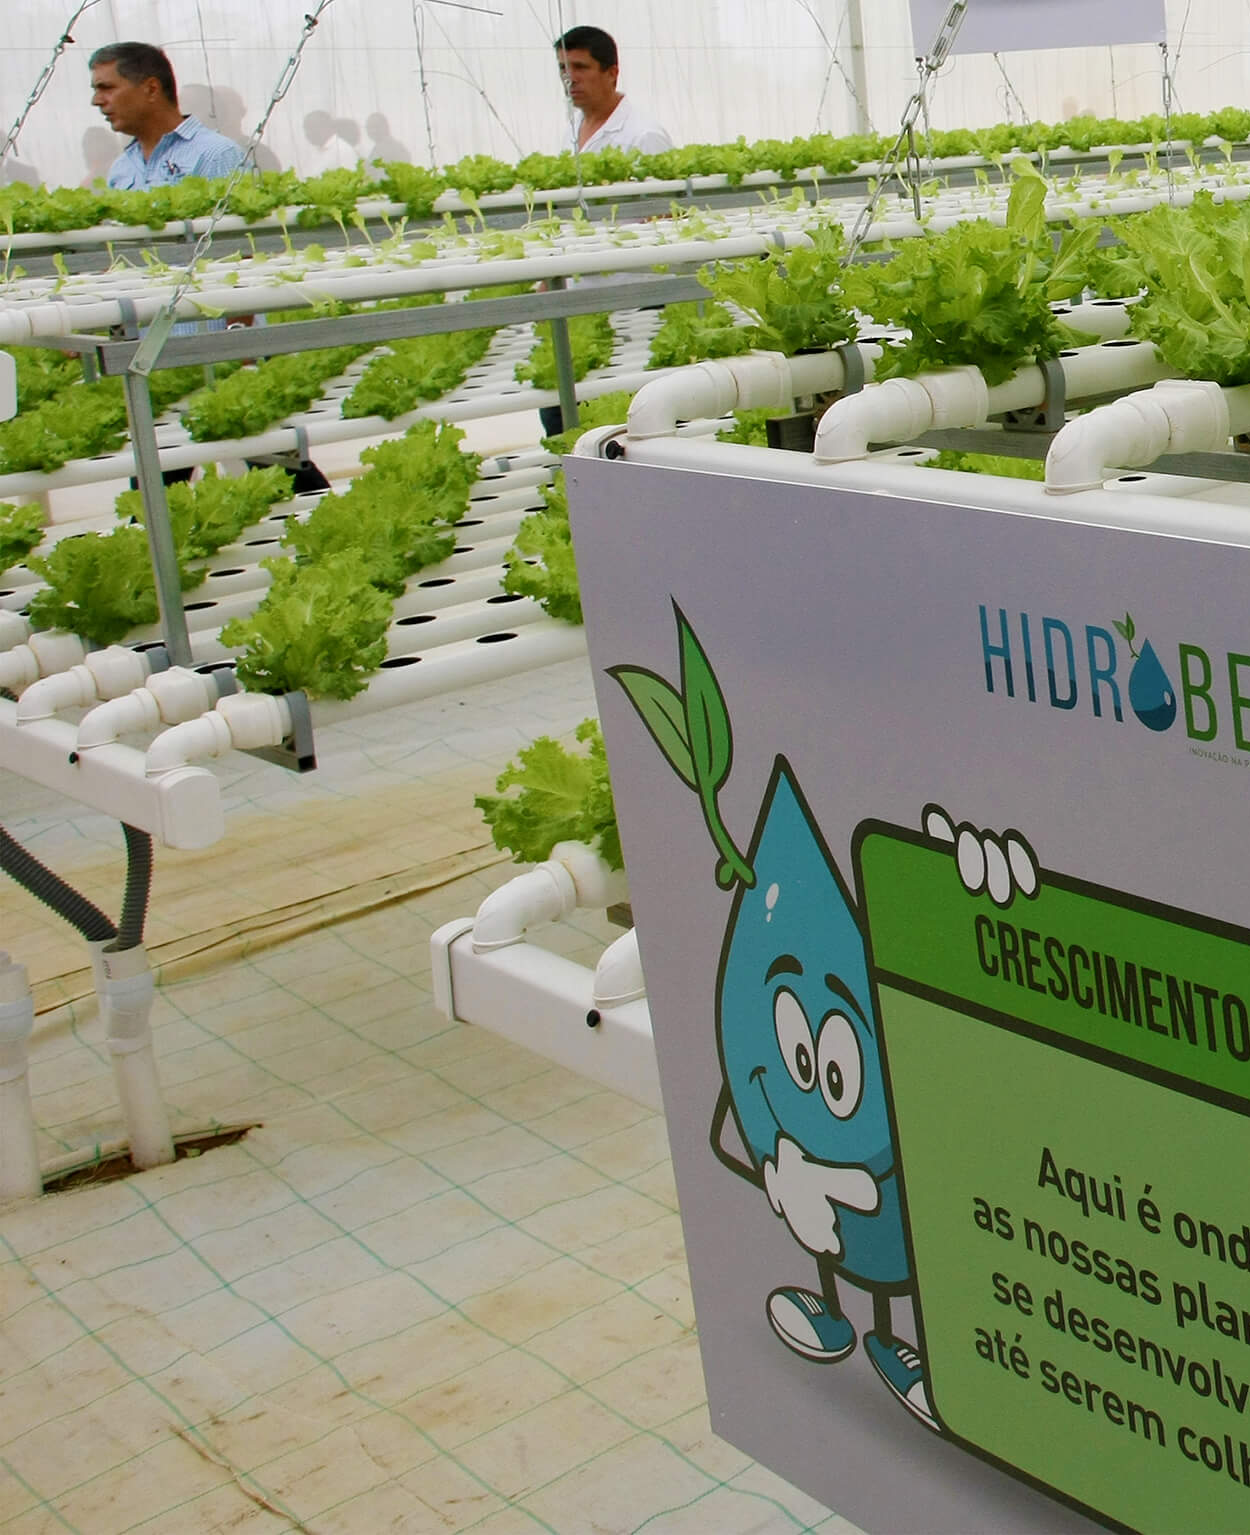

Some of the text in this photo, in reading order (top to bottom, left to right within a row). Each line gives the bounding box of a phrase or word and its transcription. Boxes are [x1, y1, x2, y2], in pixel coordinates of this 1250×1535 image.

[1189, 747, 1229, 764] INOVAÇÃO
[1231, 757, 1243, 768] NA
[1038, 1147, 1126, 1222] Aqui
[1138, 1183, 1162, 1235] é
[973, 1197, 1014, 1241] as
[1023, 1217, 1163, 1306] nossas
[992, 1271, 1034, 1317] se
[974, 1327, 1030, 1380] até
[1039, 1359, 1166, 1448] serem
